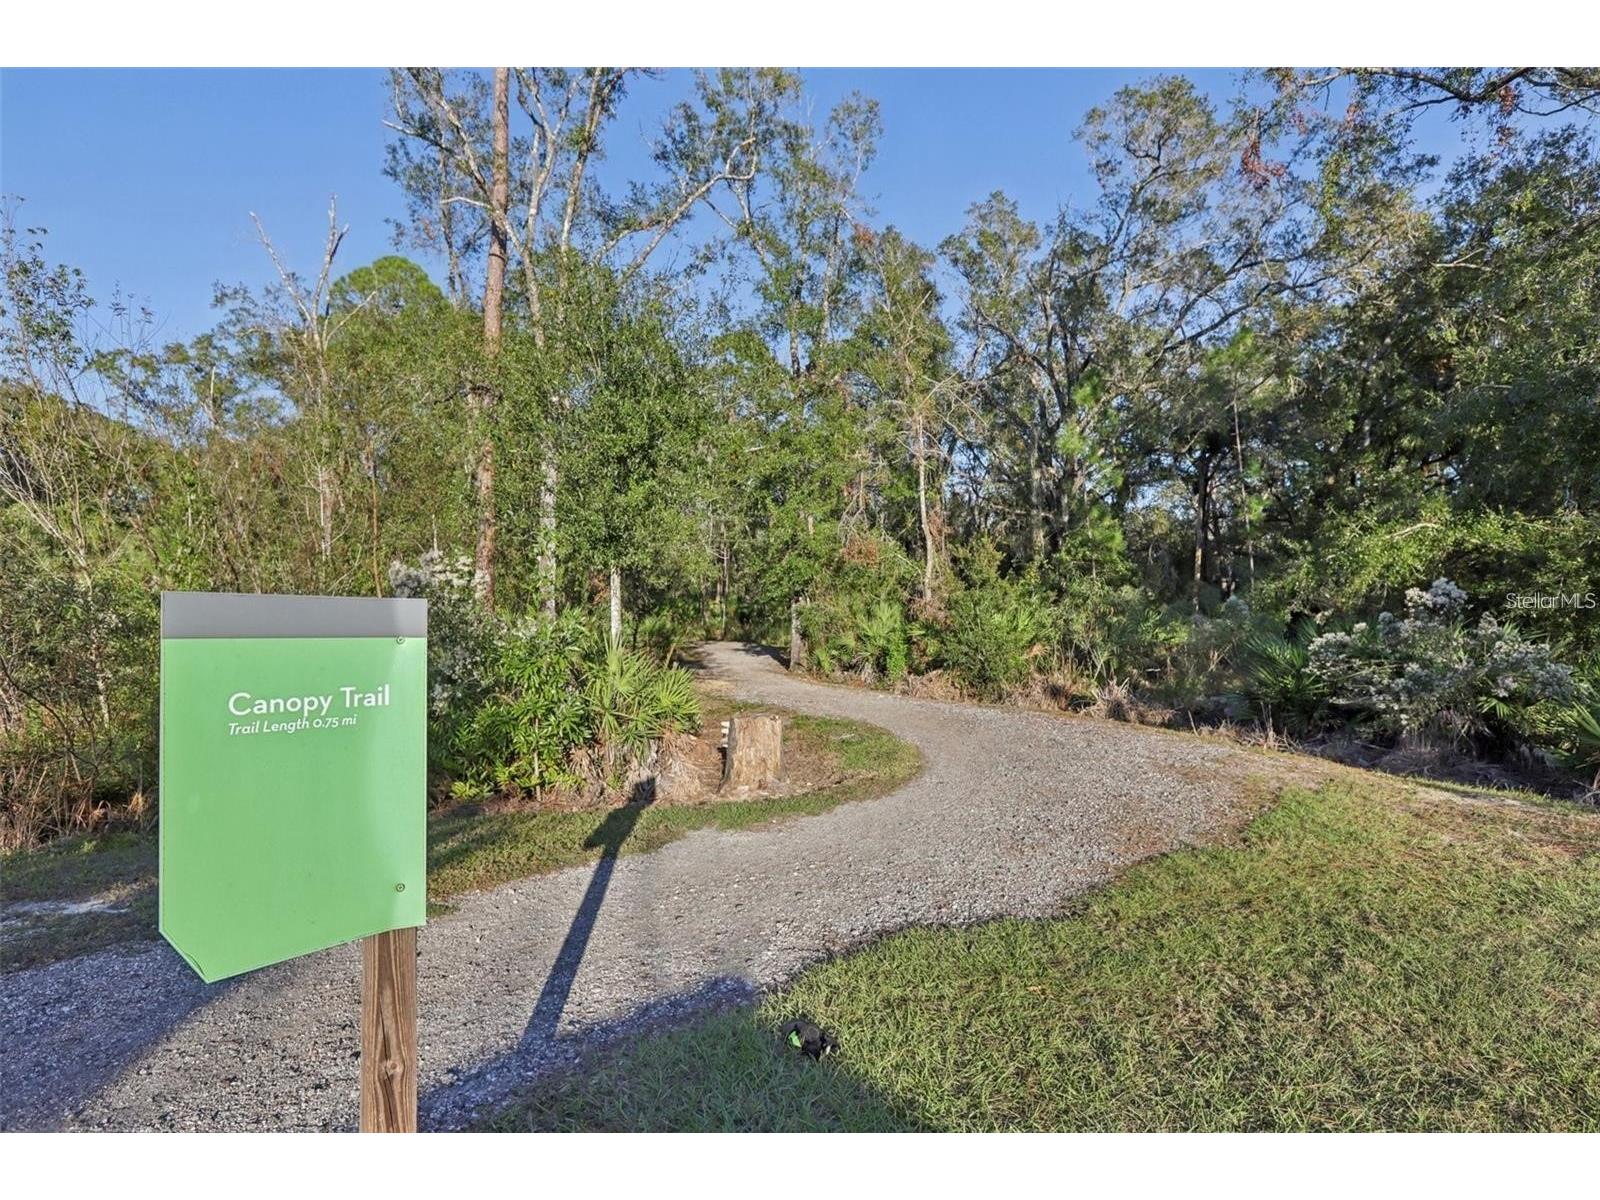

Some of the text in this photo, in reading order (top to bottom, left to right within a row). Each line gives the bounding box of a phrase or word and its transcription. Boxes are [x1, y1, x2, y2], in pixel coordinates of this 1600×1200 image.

[228, 684, 390, 717] Canopy Trail
[228, 714, 358, 735] Trail Length 0.75 mi
